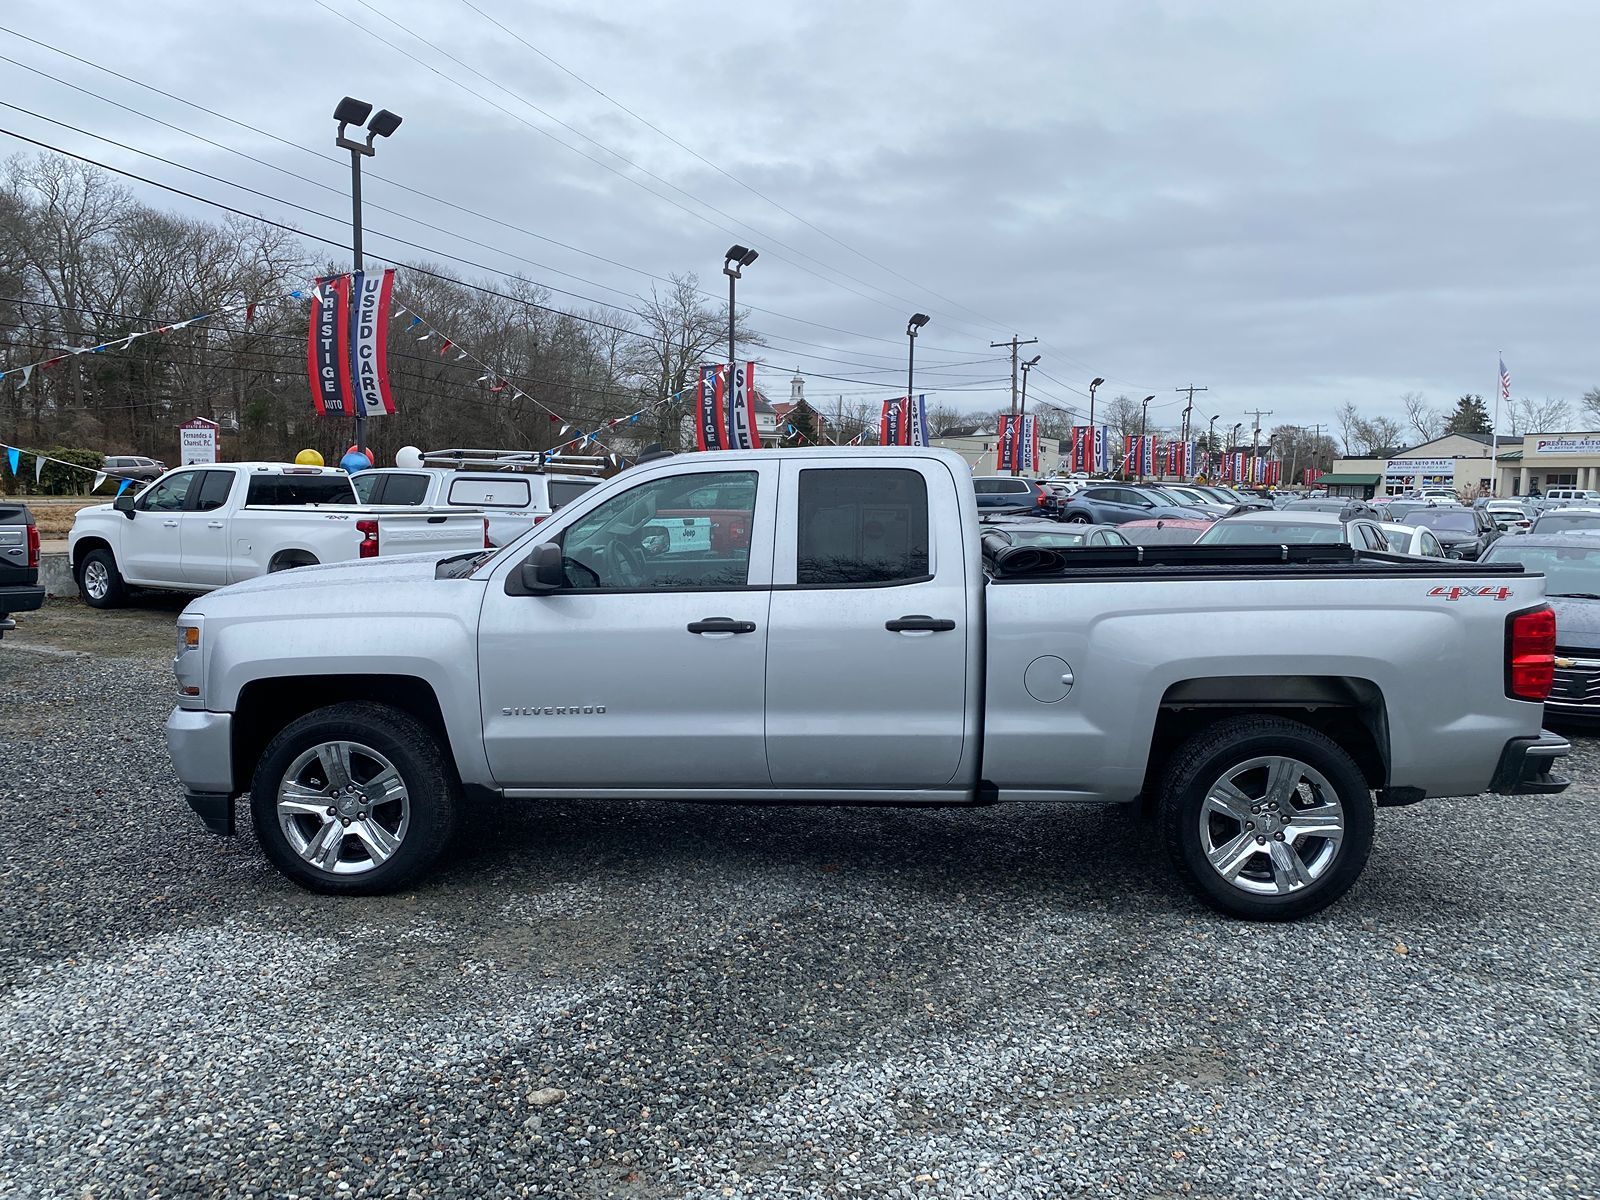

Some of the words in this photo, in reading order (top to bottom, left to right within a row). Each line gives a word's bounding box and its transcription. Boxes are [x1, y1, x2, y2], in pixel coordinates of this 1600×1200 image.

[360, 279, 379, 339] USED
[322, 284, 335, 392] PRESTIGE
[359, 345, 379, 406] CARS
[325, 400, 342, 410] AUTO
[735, 369, 750, 449] SALE
[1005, 418, 1013, 461] PRSTIGE
[1537, 440, 1576, 450] PRESTIGE
[683, 529, 695, 537] Jeep
[502, 705, 606, 716] SILVERADO
